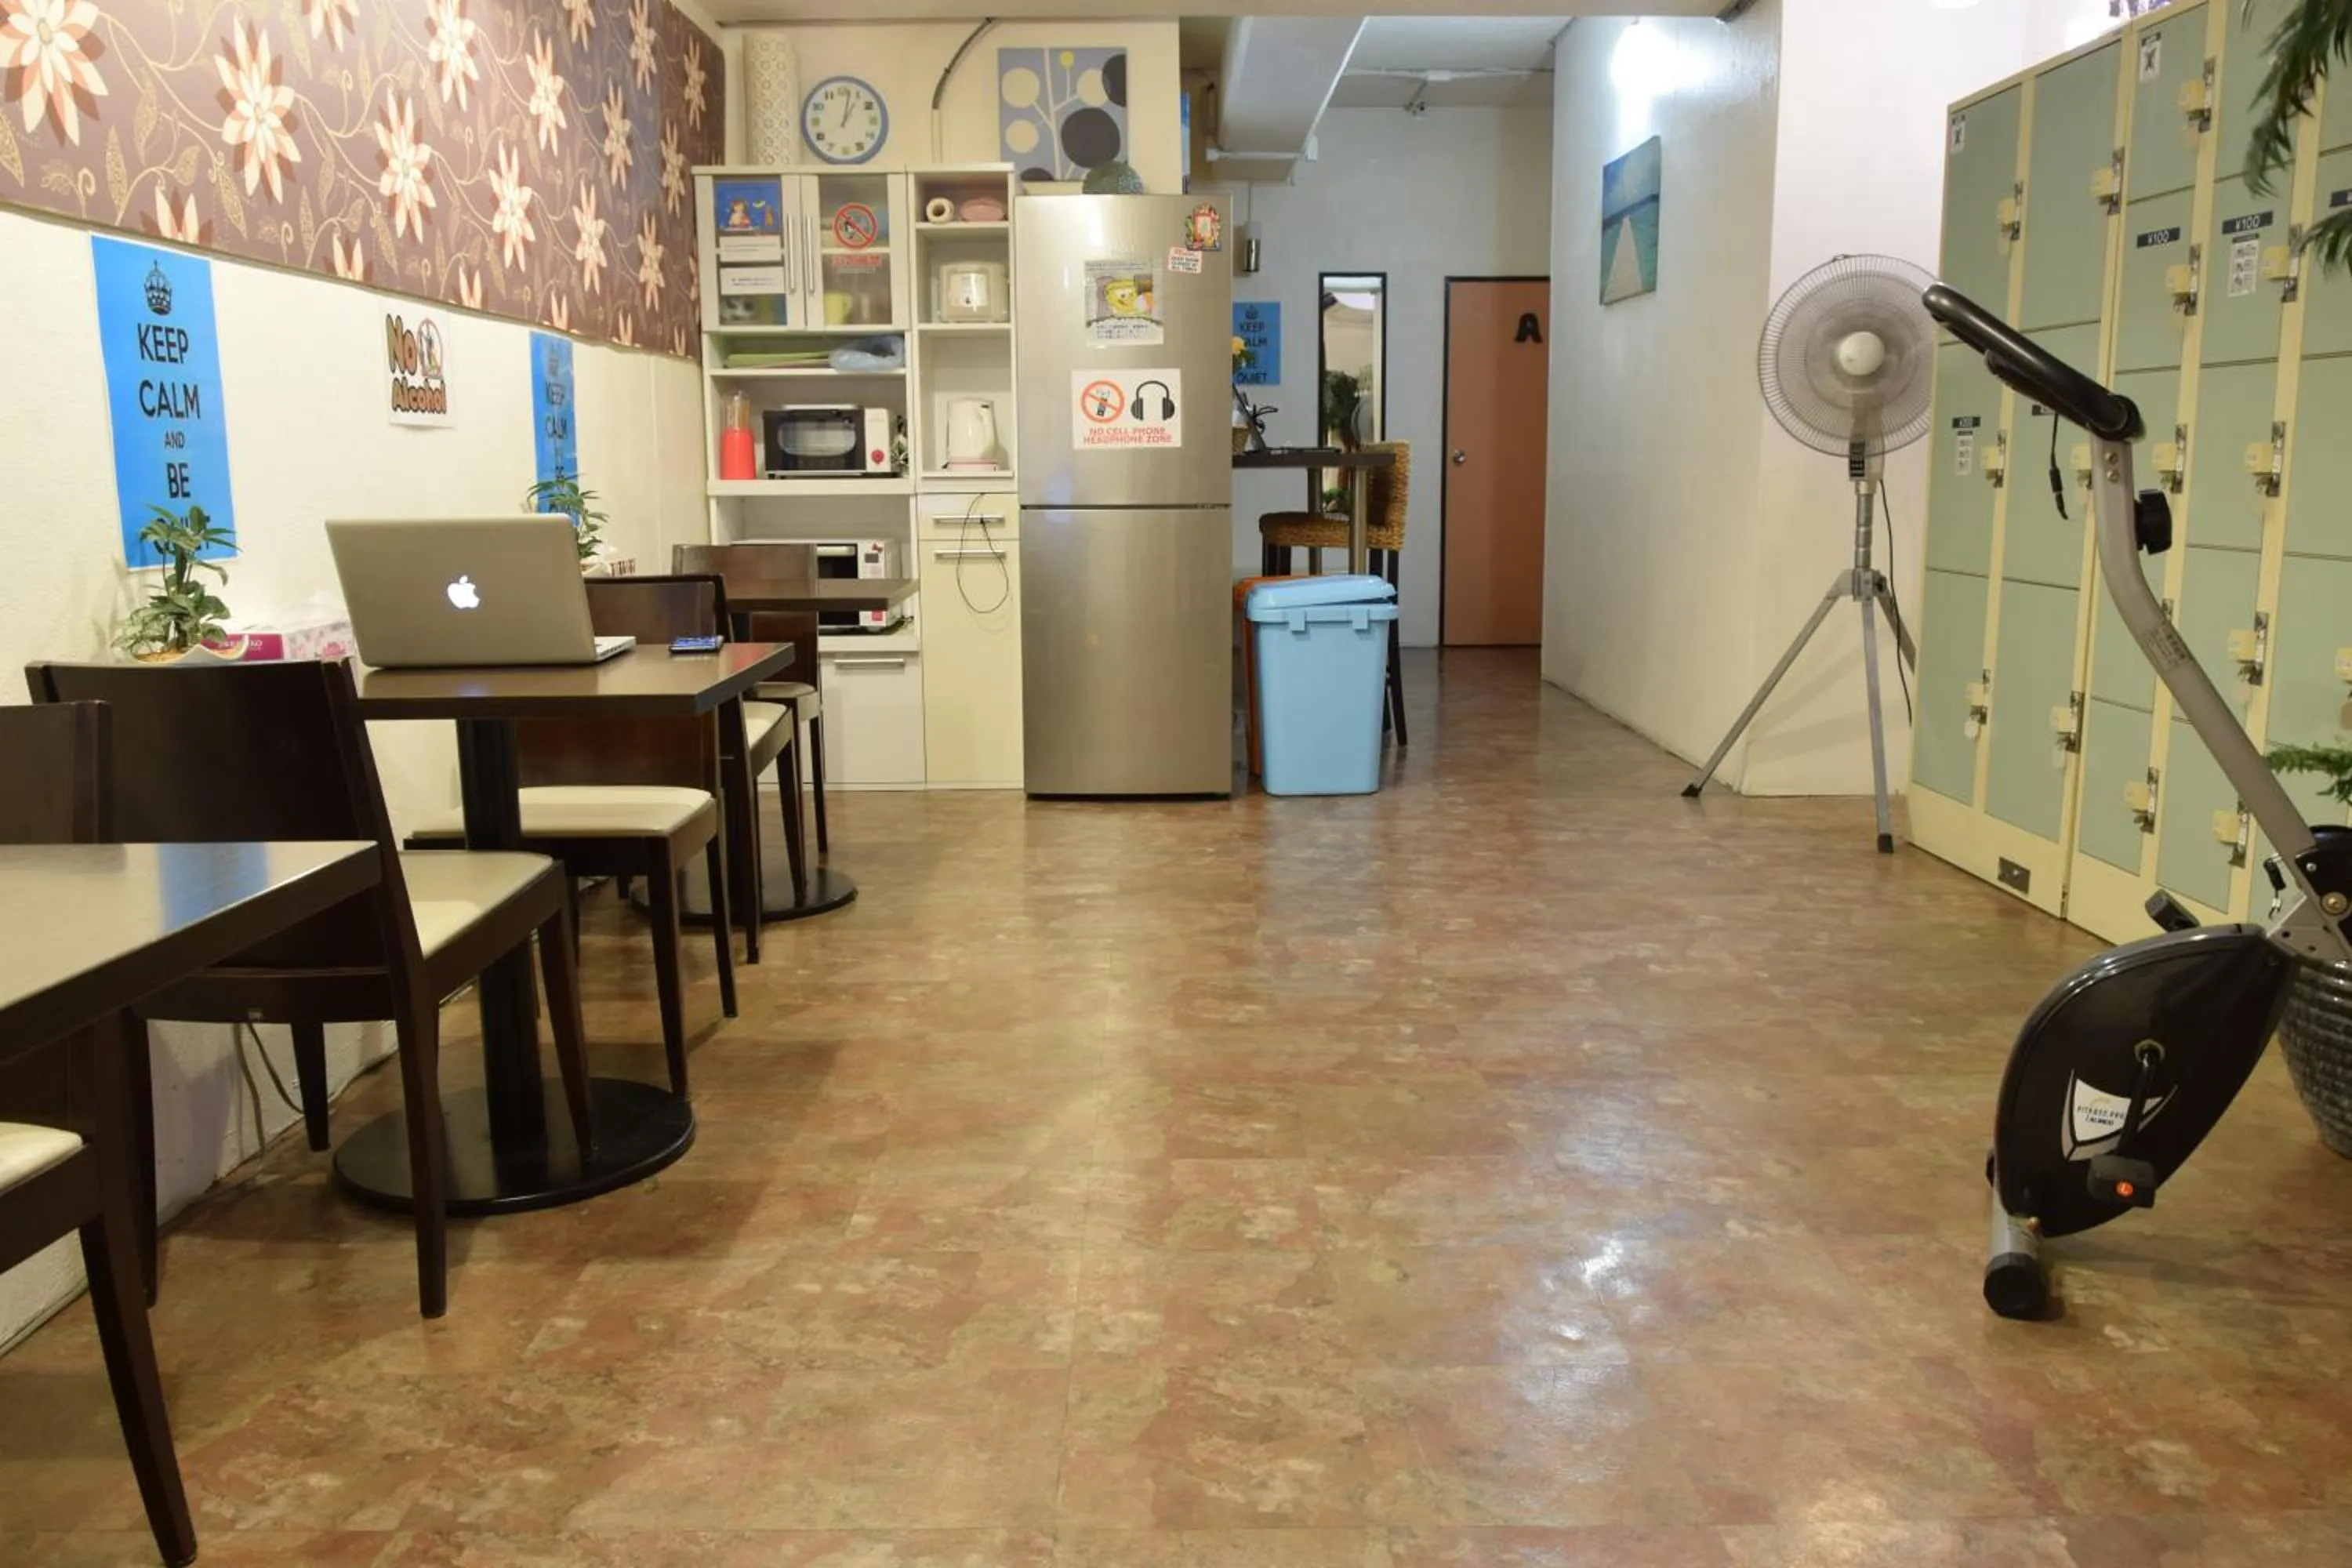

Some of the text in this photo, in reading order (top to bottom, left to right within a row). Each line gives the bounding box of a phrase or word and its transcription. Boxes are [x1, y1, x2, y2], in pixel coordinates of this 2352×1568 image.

[137, 322, 190, 365] KEEP
[386, 313, 418, 376] No
[139, 379, 201, 419] CALM
[392, 376, 447, 415] Alcohol
[164, 430, 186, 449] AND
[1089, 426, 1105, 436] NO
[1106, 426, 1130, 436] CELL
[165, 462, 191, 499] BE
